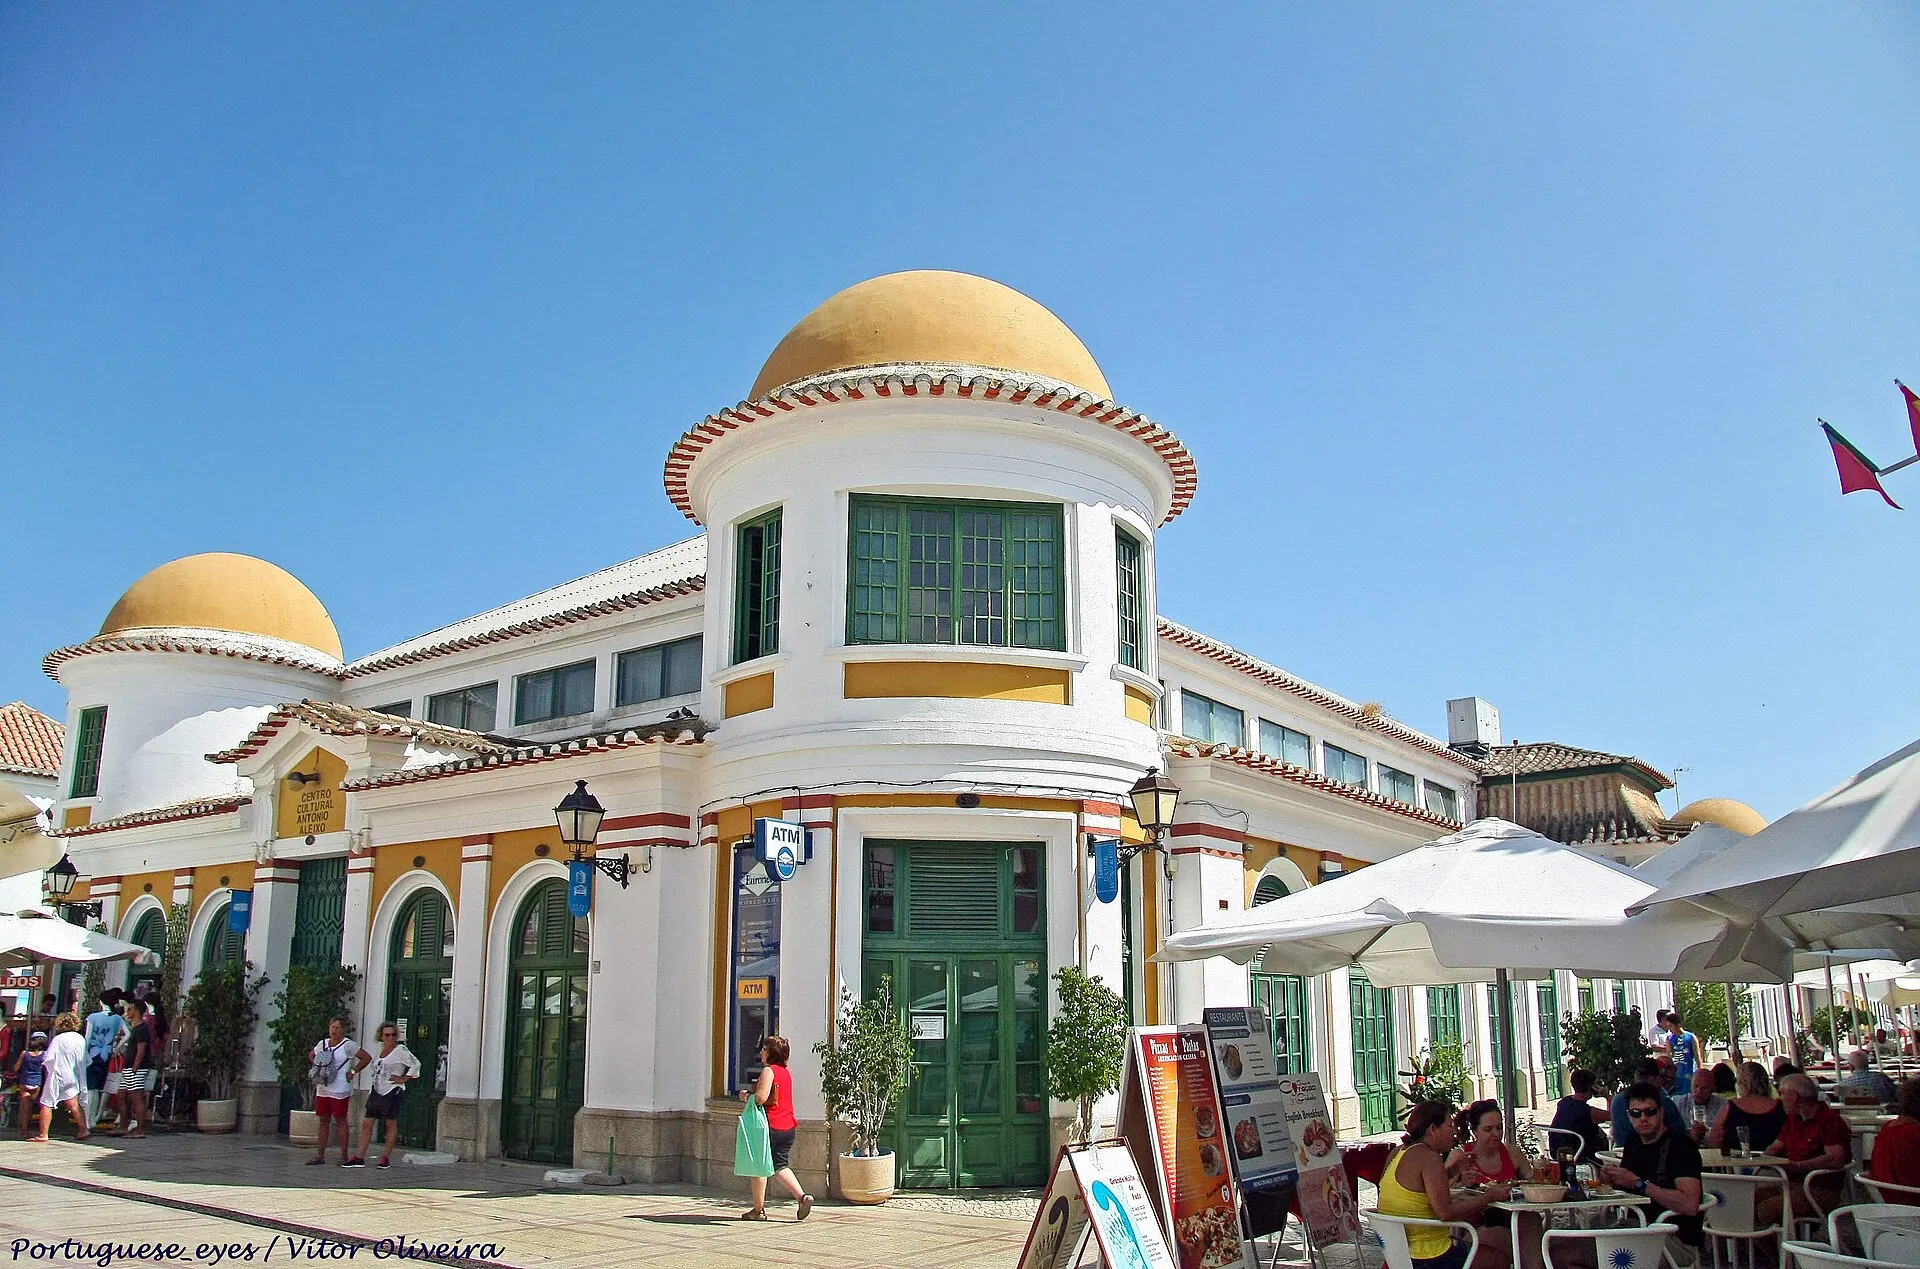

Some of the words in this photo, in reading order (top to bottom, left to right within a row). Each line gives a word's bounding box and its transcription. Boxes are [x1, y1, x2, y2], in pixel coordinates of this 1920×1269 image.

[302, 789, 331, 802] CENTRO
[297, 800, 334, 814] CULTURAL
[299, 823, 326, 835] ALEIXO
[772, 827, 800, 844] ATM
[743, 984, 763, 995] ATM
[1210, 1012, 1245, 1023] RESTAURANTE
[1149, 1038, 1169, 1055] Pizzas
[1285, 1111, 1303, 1123] English
[1302, 1108, 1325, 1120] Breakfast
[1312, 1225, 1340, 1241] BRUNCH
